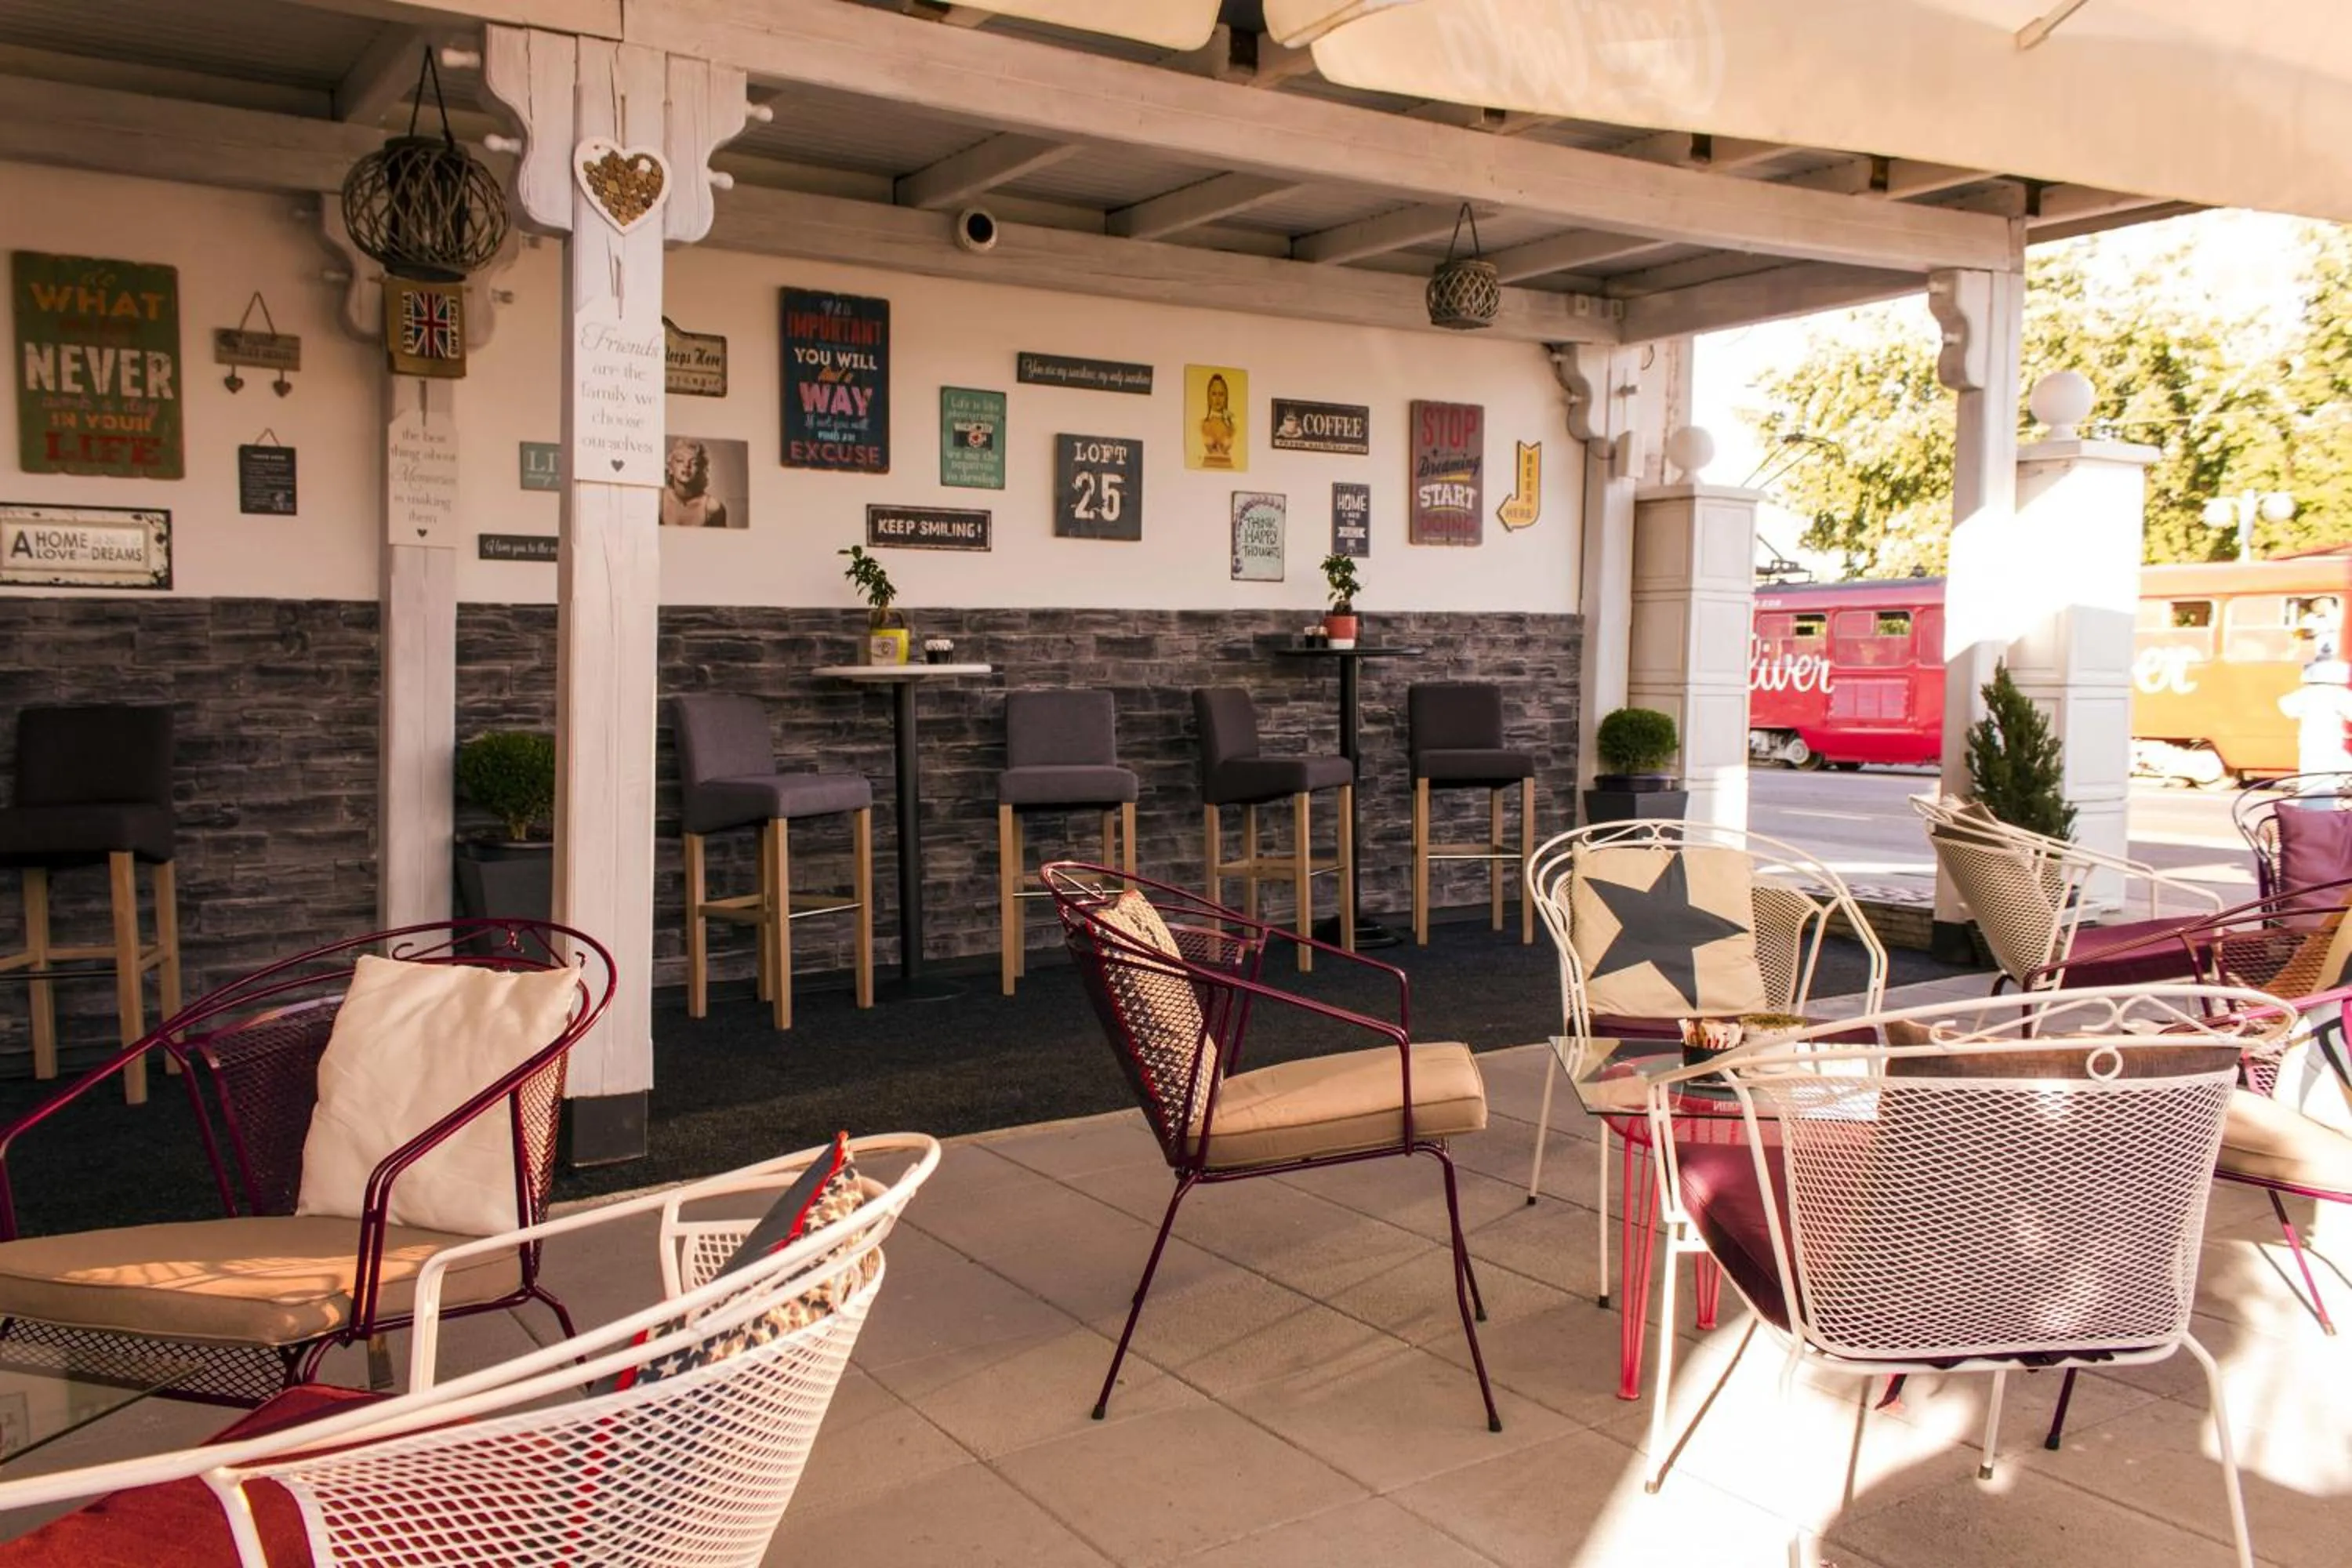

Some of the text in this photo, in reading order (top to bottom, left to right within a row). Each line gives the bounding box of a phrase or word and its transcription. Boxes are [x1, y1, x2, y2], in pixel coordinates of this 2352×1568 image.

[29, 281, 164, 321] WHAT
[581, 321, 661, 359] Friends
[787, 313, 882, 346] IMPORTANT
[25, 341, 173, 399] NEVER
[592, 361, 647, 381] are the
[794, 348, 878, 370] YOU WILL
[581, 382, 656, 406] family we
[798, 382, 873, 417] WAY
[51, 412, 152, 431] IN YOUR
[592, 408, 644, 429] choose
[1302, 413, 1363, 439] COFFEE
[1421, 405, 1477, 449] STOP
[46, 431, 162, 465] LIFE
[582, 434, 653, 454] ourselves
[790, 440, 880, 465] EXCUSE
[1073, 442, 1127, 465] LOFT
[527, 450, 561, 474] LI
[1072, 471, 1123, 521] 25
[1337, 494, 1367, 512] HOME
[1418, 484, 1478, 510] START
[877, 518, 915, 535] KEEP
[11, 530, 33, 558] A
[35, 532, 89, 549] HOME
[36, 547, 142, 562] LOVE DREAMS
